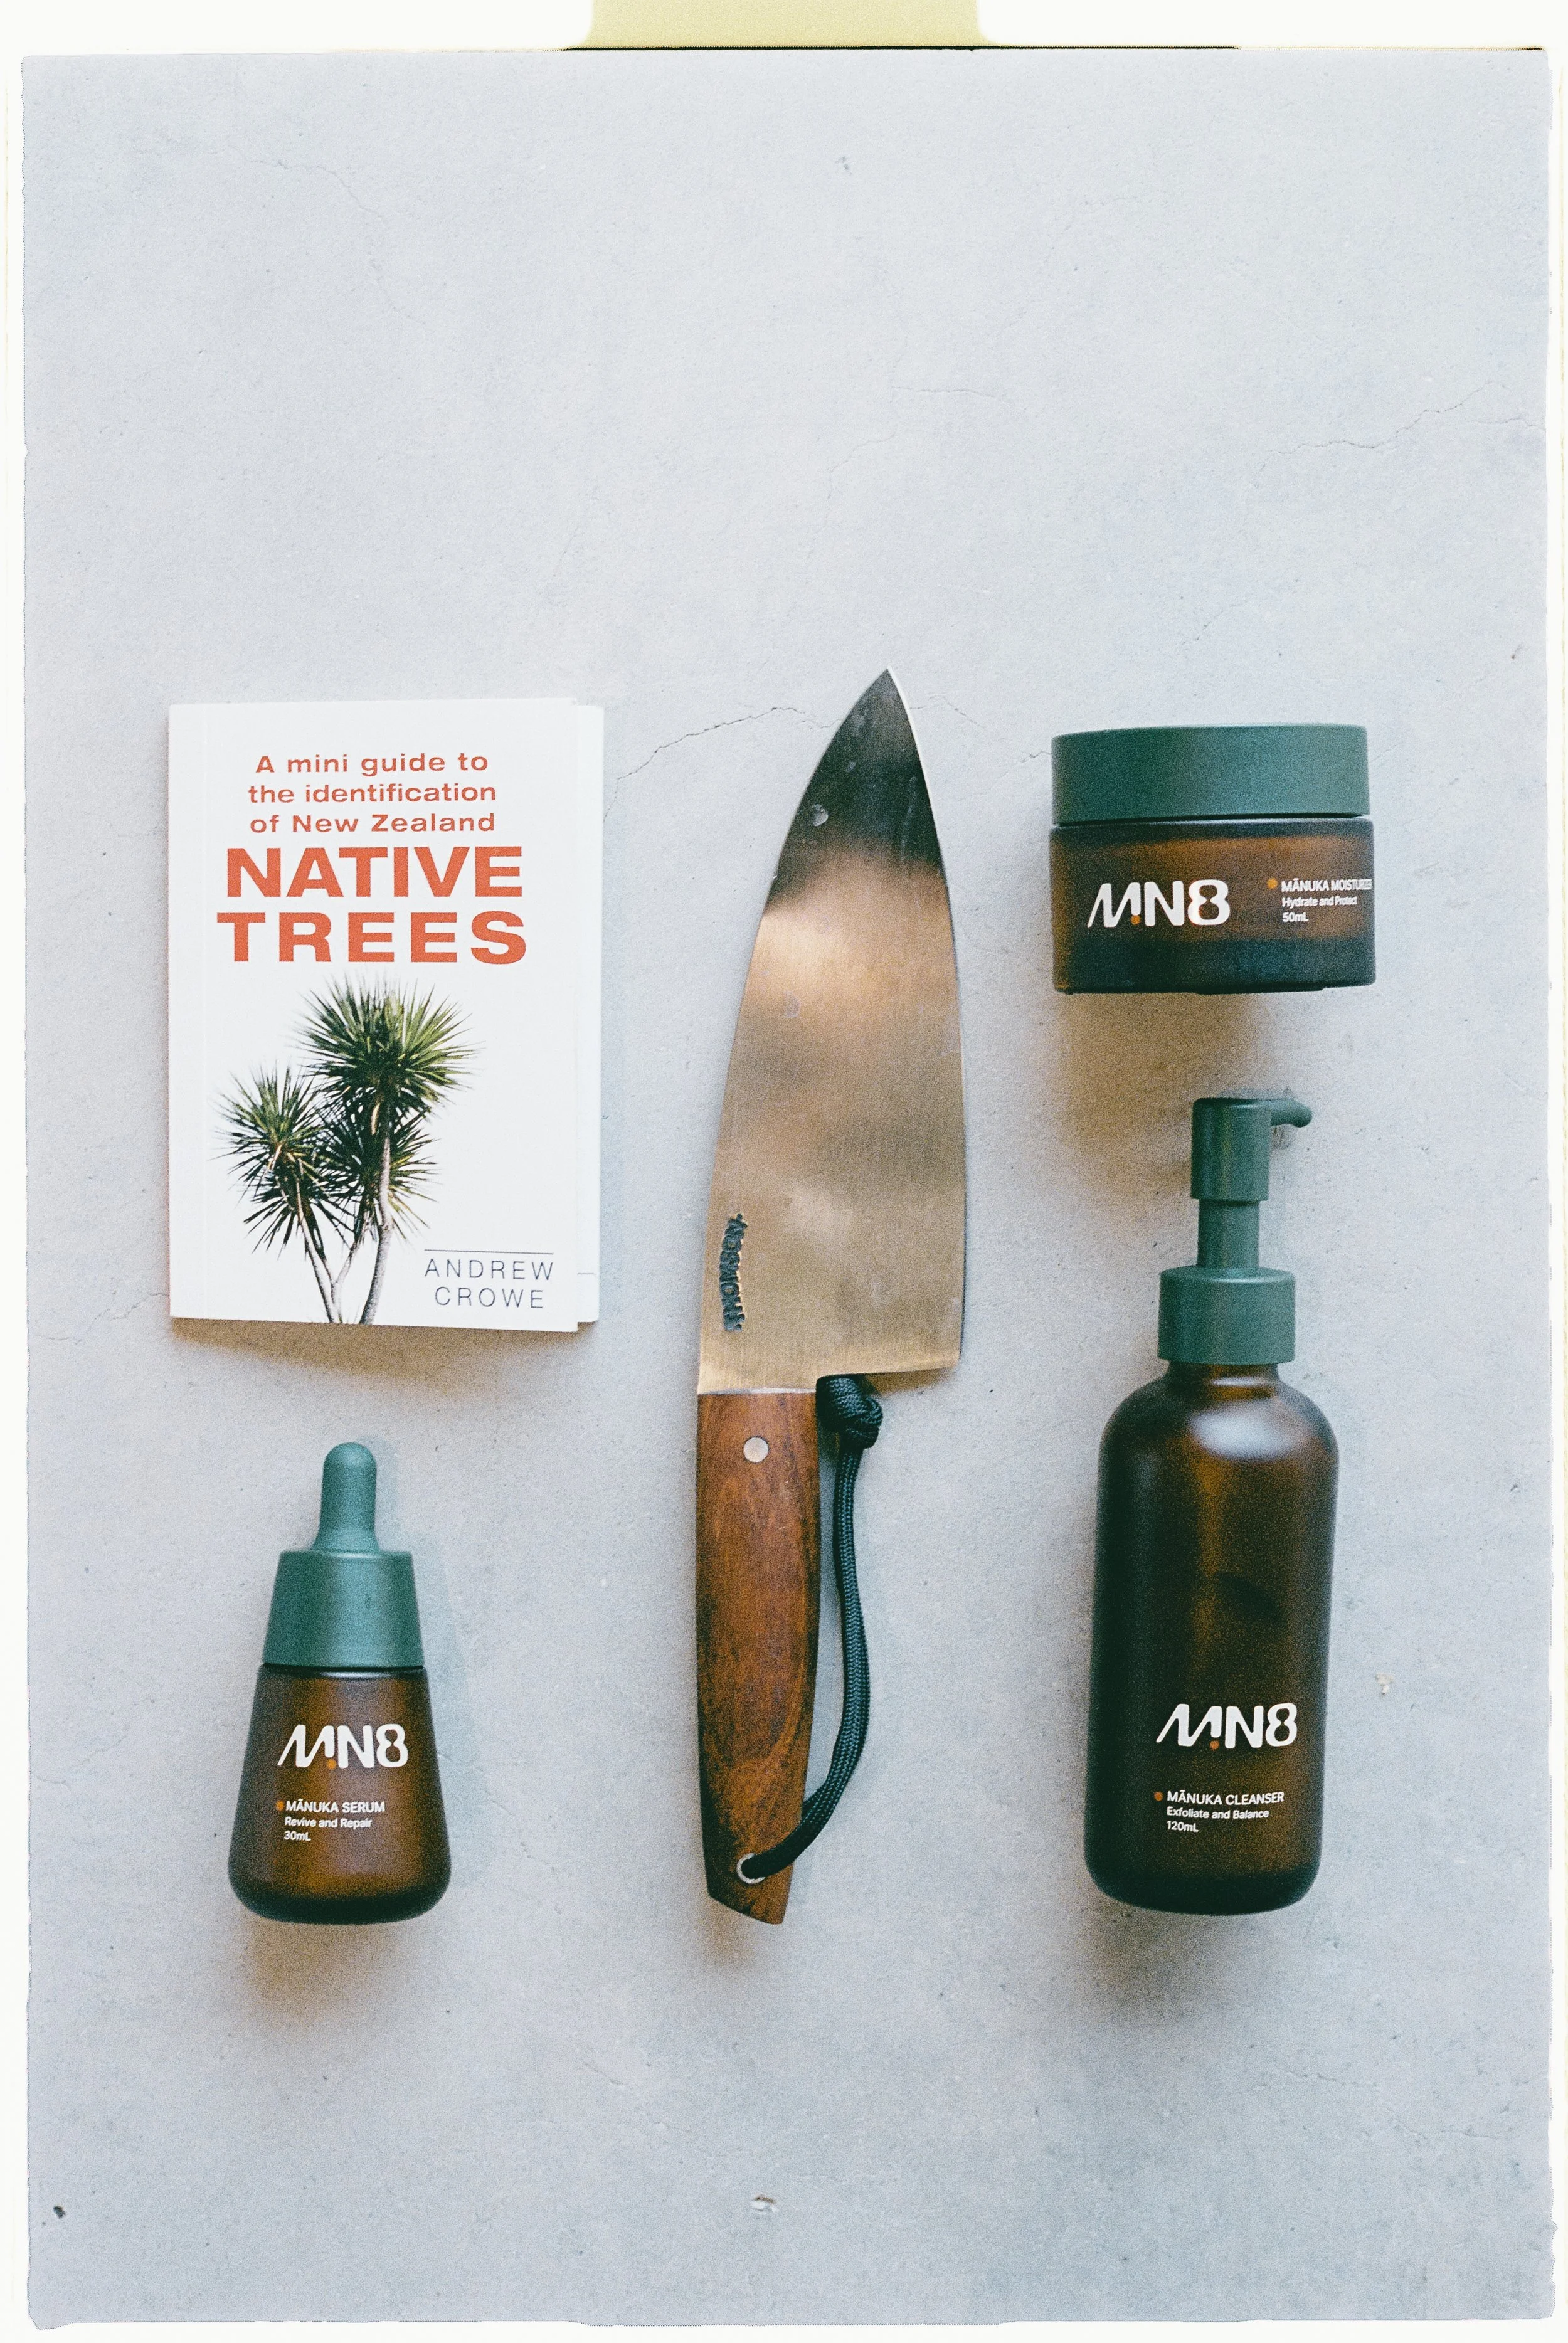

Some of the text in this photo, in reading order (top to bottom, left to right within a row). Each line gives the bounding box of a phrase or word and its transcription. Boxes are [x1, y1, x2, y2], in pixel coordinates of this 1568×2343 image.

[256, 753, 488, 776] A mini guide to
[248, 783, 495, 803] the identification
[250, 813, 495, 833] of New Zealand
[227, 846, 522, 897] NATIVE
[1088, 879, 1231, 928] MN8
[1282, 897, 1318, 909] Hydrate
[1319, 897, 1334, 905] and
[1283, 912, 1309, 922] 50mL
[217, 911, 526, 964] TREES
[424, 1259, 553, 1281] ANDREW
[435, 1286, 543, 1309] CROWE
[1156, 1703, 1298, 1749] MN8
[277, 1724, 408, 1769] MN8
[342, 1801, 385, 1813] SERUM
[1225, 1792, 1285, 1805] CLEANSER
[1167, 1806, 1269, 1819] Exfoliate and Balance
[285, 1816, 373, 1830] Revive and Repair
[1167, 1820, 1199, 1832] 120mL
[283, 1831, 311, 1841] 30mL
